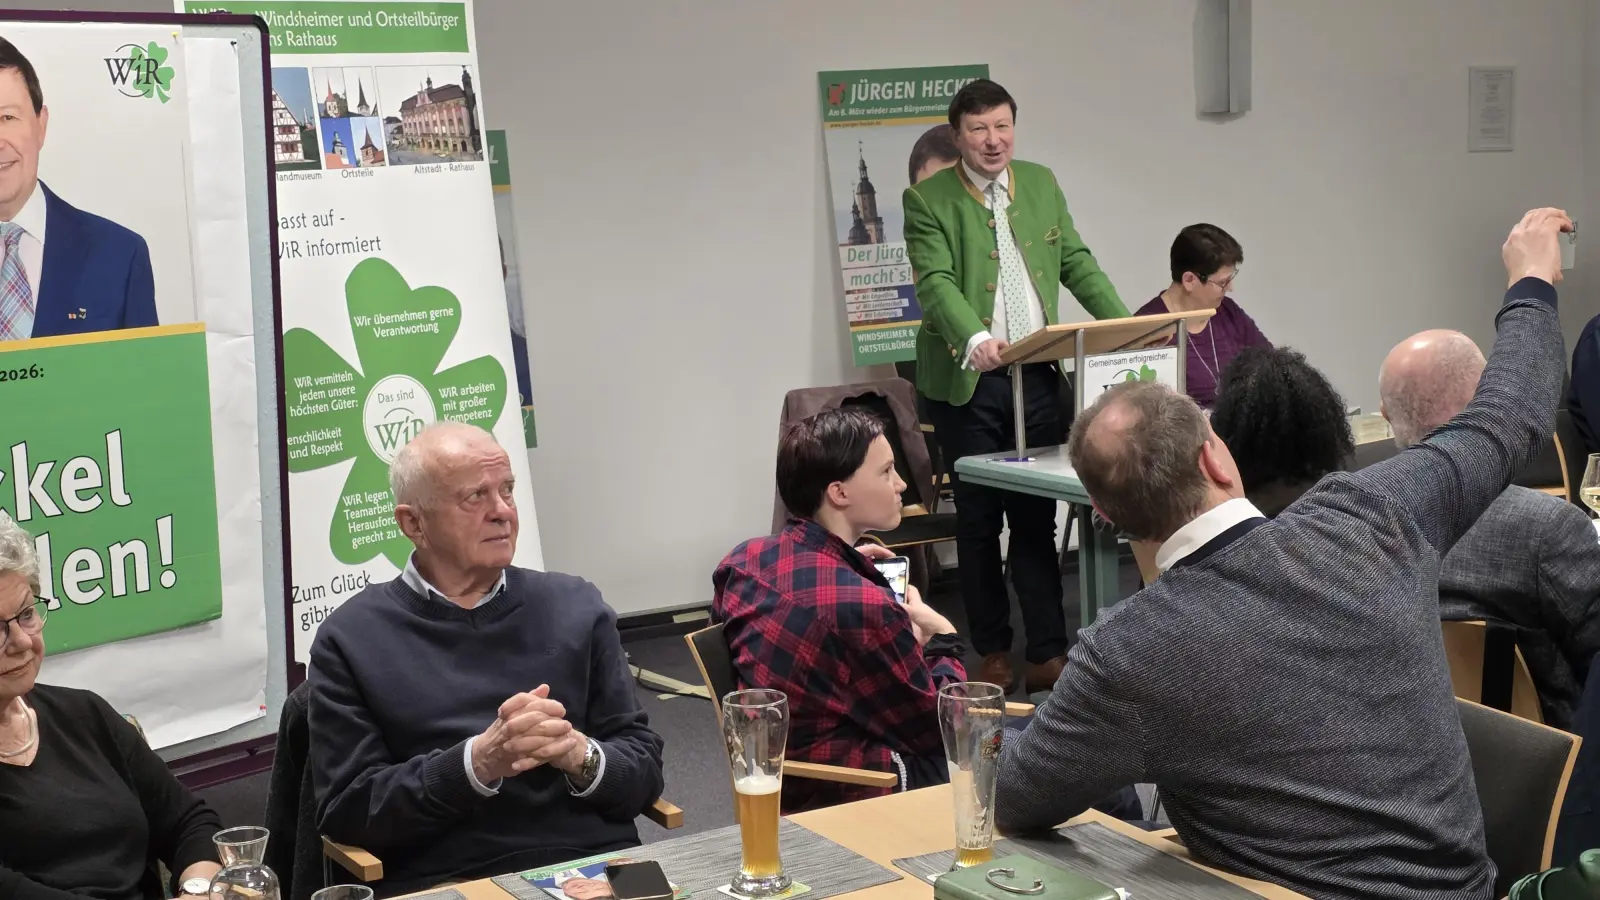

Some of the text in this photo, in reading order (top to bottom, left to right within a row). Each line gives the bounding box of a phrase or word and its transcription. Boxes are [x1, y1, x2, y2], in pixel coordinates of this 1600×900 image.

[348, 11, 371, 26] und
[375, 11, 459, 30] Ortsteilbürger
[269, 31, 337, 46] ns Rathaus
[103, 54, 163, 85] WiR
[850, 77, 980, 105] JÜRGEN HECK
[866, 107, 888, 115] wieder
[904, 104, 950, 114] Bürgermeister
[277, 172, 322, 182] landmuseum
[341, 169, 374, 178] Ortsteile
[414, 165, 442, 174] Altstadt
[449, 163, 475, 172] Rathaus
[278, 213, 307, 230] asst
[313, 209, 334, 227] auf
[306, 236, 382, 257] informiert
[847, 247, 872, 262] Der
[374, 310, 428, 325] übernehmen
[429, 308, 454, 321] gerne
[373, 322, 439, 338] Verantwortung
[856, 329, 908, 342] WINDSHEIMER
[1088, 356, 1127, 368] Gemeinsam
[0, 363, 44, 382] 2026:
[294, 371, 353, 388] WiR vermitteln
[299, 386, 356, 404] jedem unsere
[377, 389, 414, 404] Das sind
[439, 383, 496, 399] WiR arbeiten
[290, 399, 358, 417] höchsten Güter:
[443, 396, 487, 411] mit großer
[444, 409, 493, 424] Kompetenz
[287, 427, 342, 446] enschlichkeit
[289, 441, 344, 459] und Respekt
[0, 428, 133, 522] kel
[342, 493, 362, 507] WiR
[365, 490, 388, 505] legen
[344, 501, 394, 520] Teamarbeit
[352, 531, 384, 550] gerecht
[386, 529, 397, 540] zu
[34, 513, 178, 611] len!
[291, 570, 371, 604] Zum Glück
